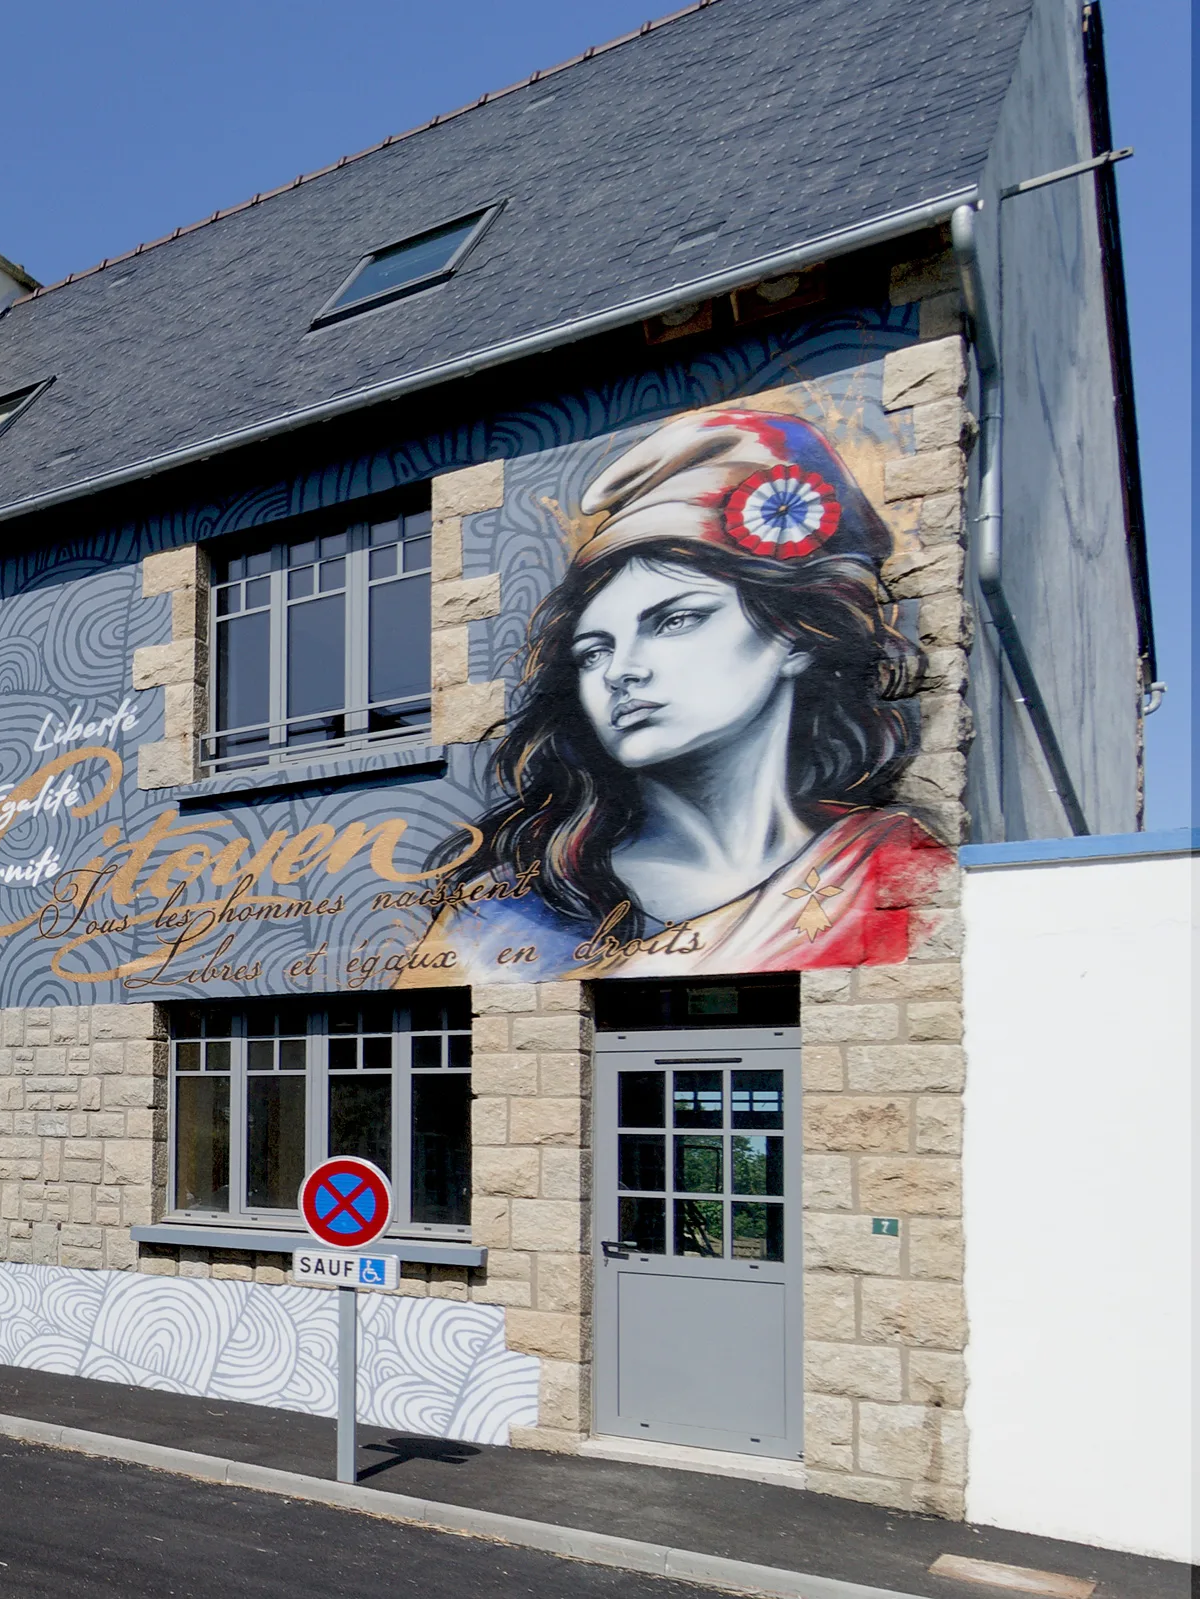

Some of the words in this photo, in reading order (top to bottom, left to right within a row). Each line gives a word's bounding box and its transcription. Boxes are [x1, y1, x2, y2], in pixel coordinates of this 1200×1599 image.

[33, 698, 140, 752] Liberté
[32, 863, 130, 941] Tous
[153, 879, 193, 930] les
[216, 872, 345, 923] hommes
[371, 859, 540, 912] naissent
[288, 942, 327, 977] et
[345, 938, 457, 989] égaux
[496, 943, 538, 966] en
[573, 899, 705, 963] droits
[881, 1220, 890, 1234] 7
[300, 1257, 354, 1277] SAUF
